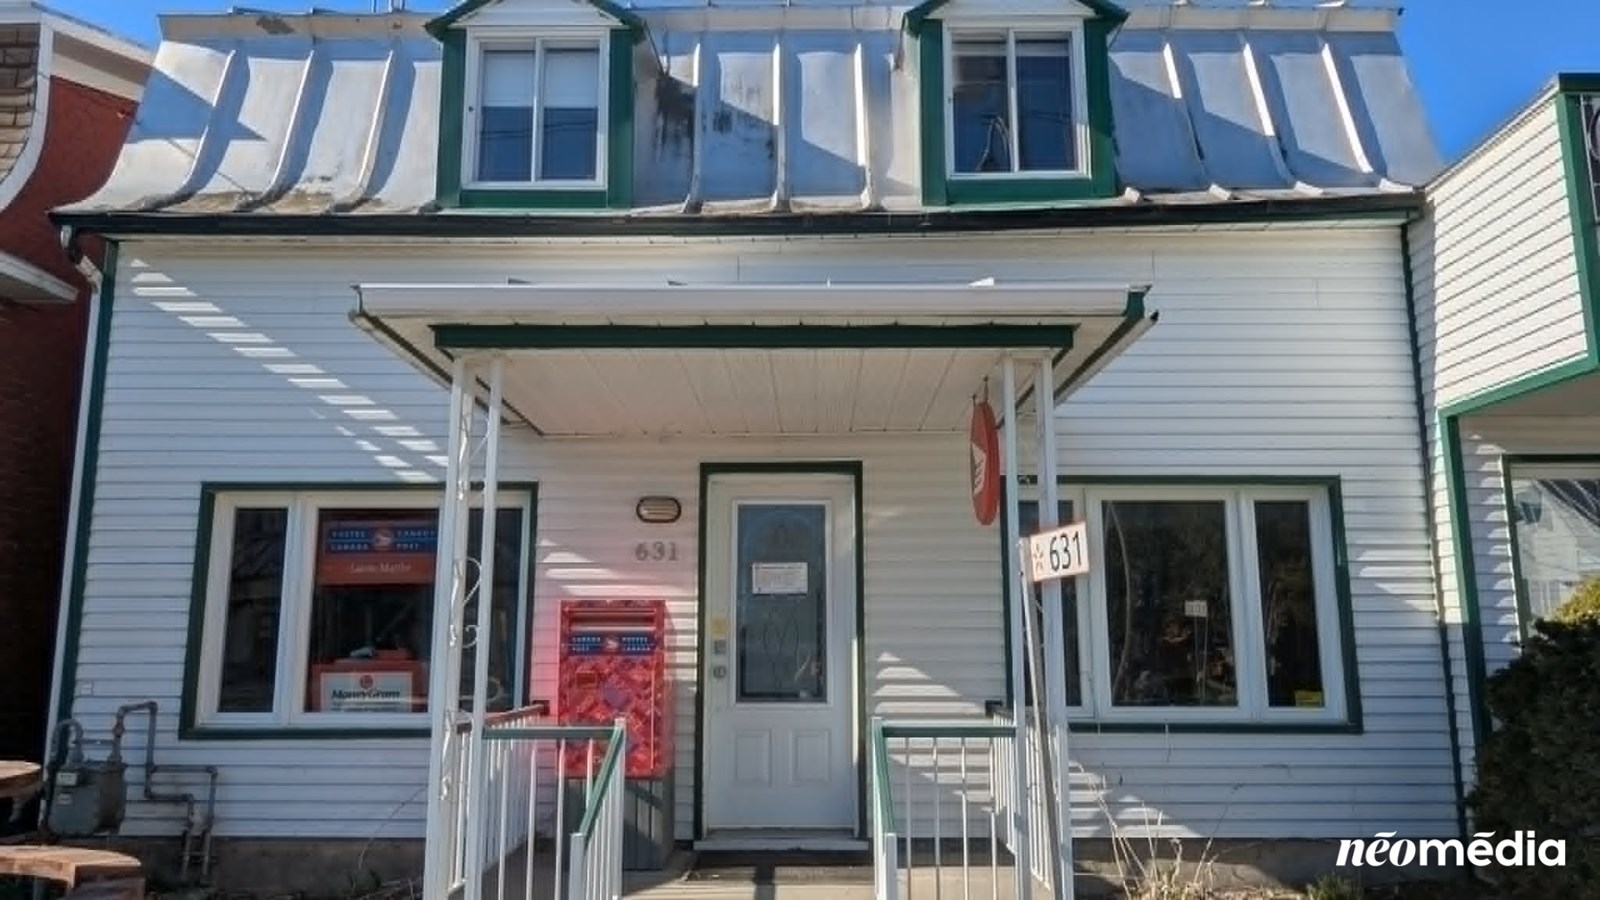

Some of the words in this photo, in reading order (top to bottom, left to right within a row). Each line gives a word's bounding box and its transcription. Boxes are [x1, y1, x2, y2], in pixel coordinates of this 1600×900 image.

[330, 543, 369, 551] CANADA
[635, 541, 676, 561] 631
[1051, 531, 1082, 571] 631
[331, 688, 401, 699] MoneyGram
